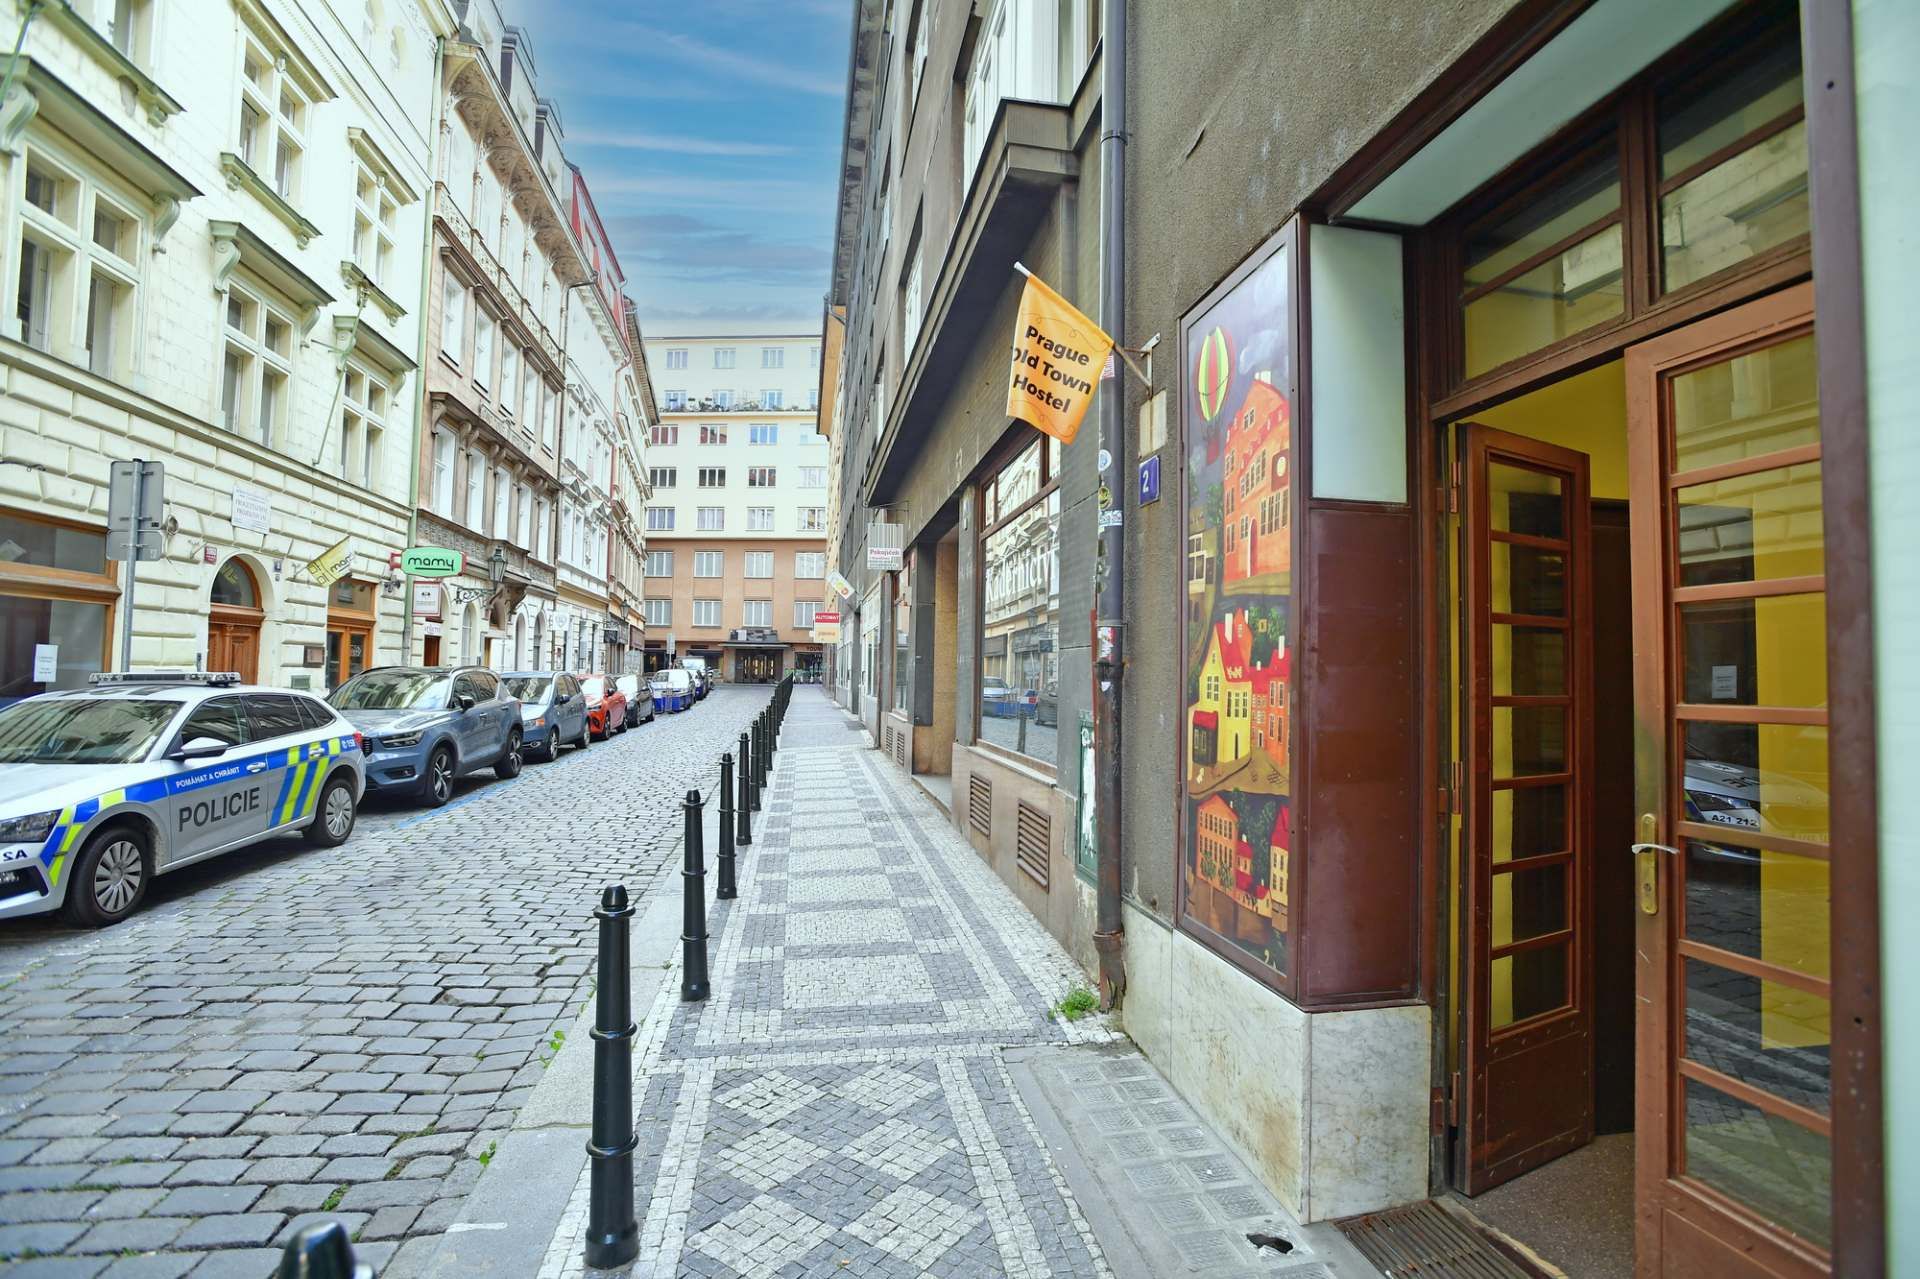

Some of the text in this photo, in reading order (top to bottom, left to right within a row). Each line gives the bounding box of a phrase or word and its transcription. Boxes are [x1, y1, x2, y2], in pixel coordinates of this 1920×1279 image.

[1025, 325, 1090, 366] Prague
[1042, 361, 1092, 395] Town
[1013, 374, 1071, 413] Hostel
[1142, 470, 1150, 494] 2
[408, 557, 454, 572] mamy
[175, 773, 208, 789] POMÁHAT
[214, 766, 240, 780] CHRÁNIT
[178, 787, 261, 832] POLICIE
[1711, 814, 1732, 824] A21
